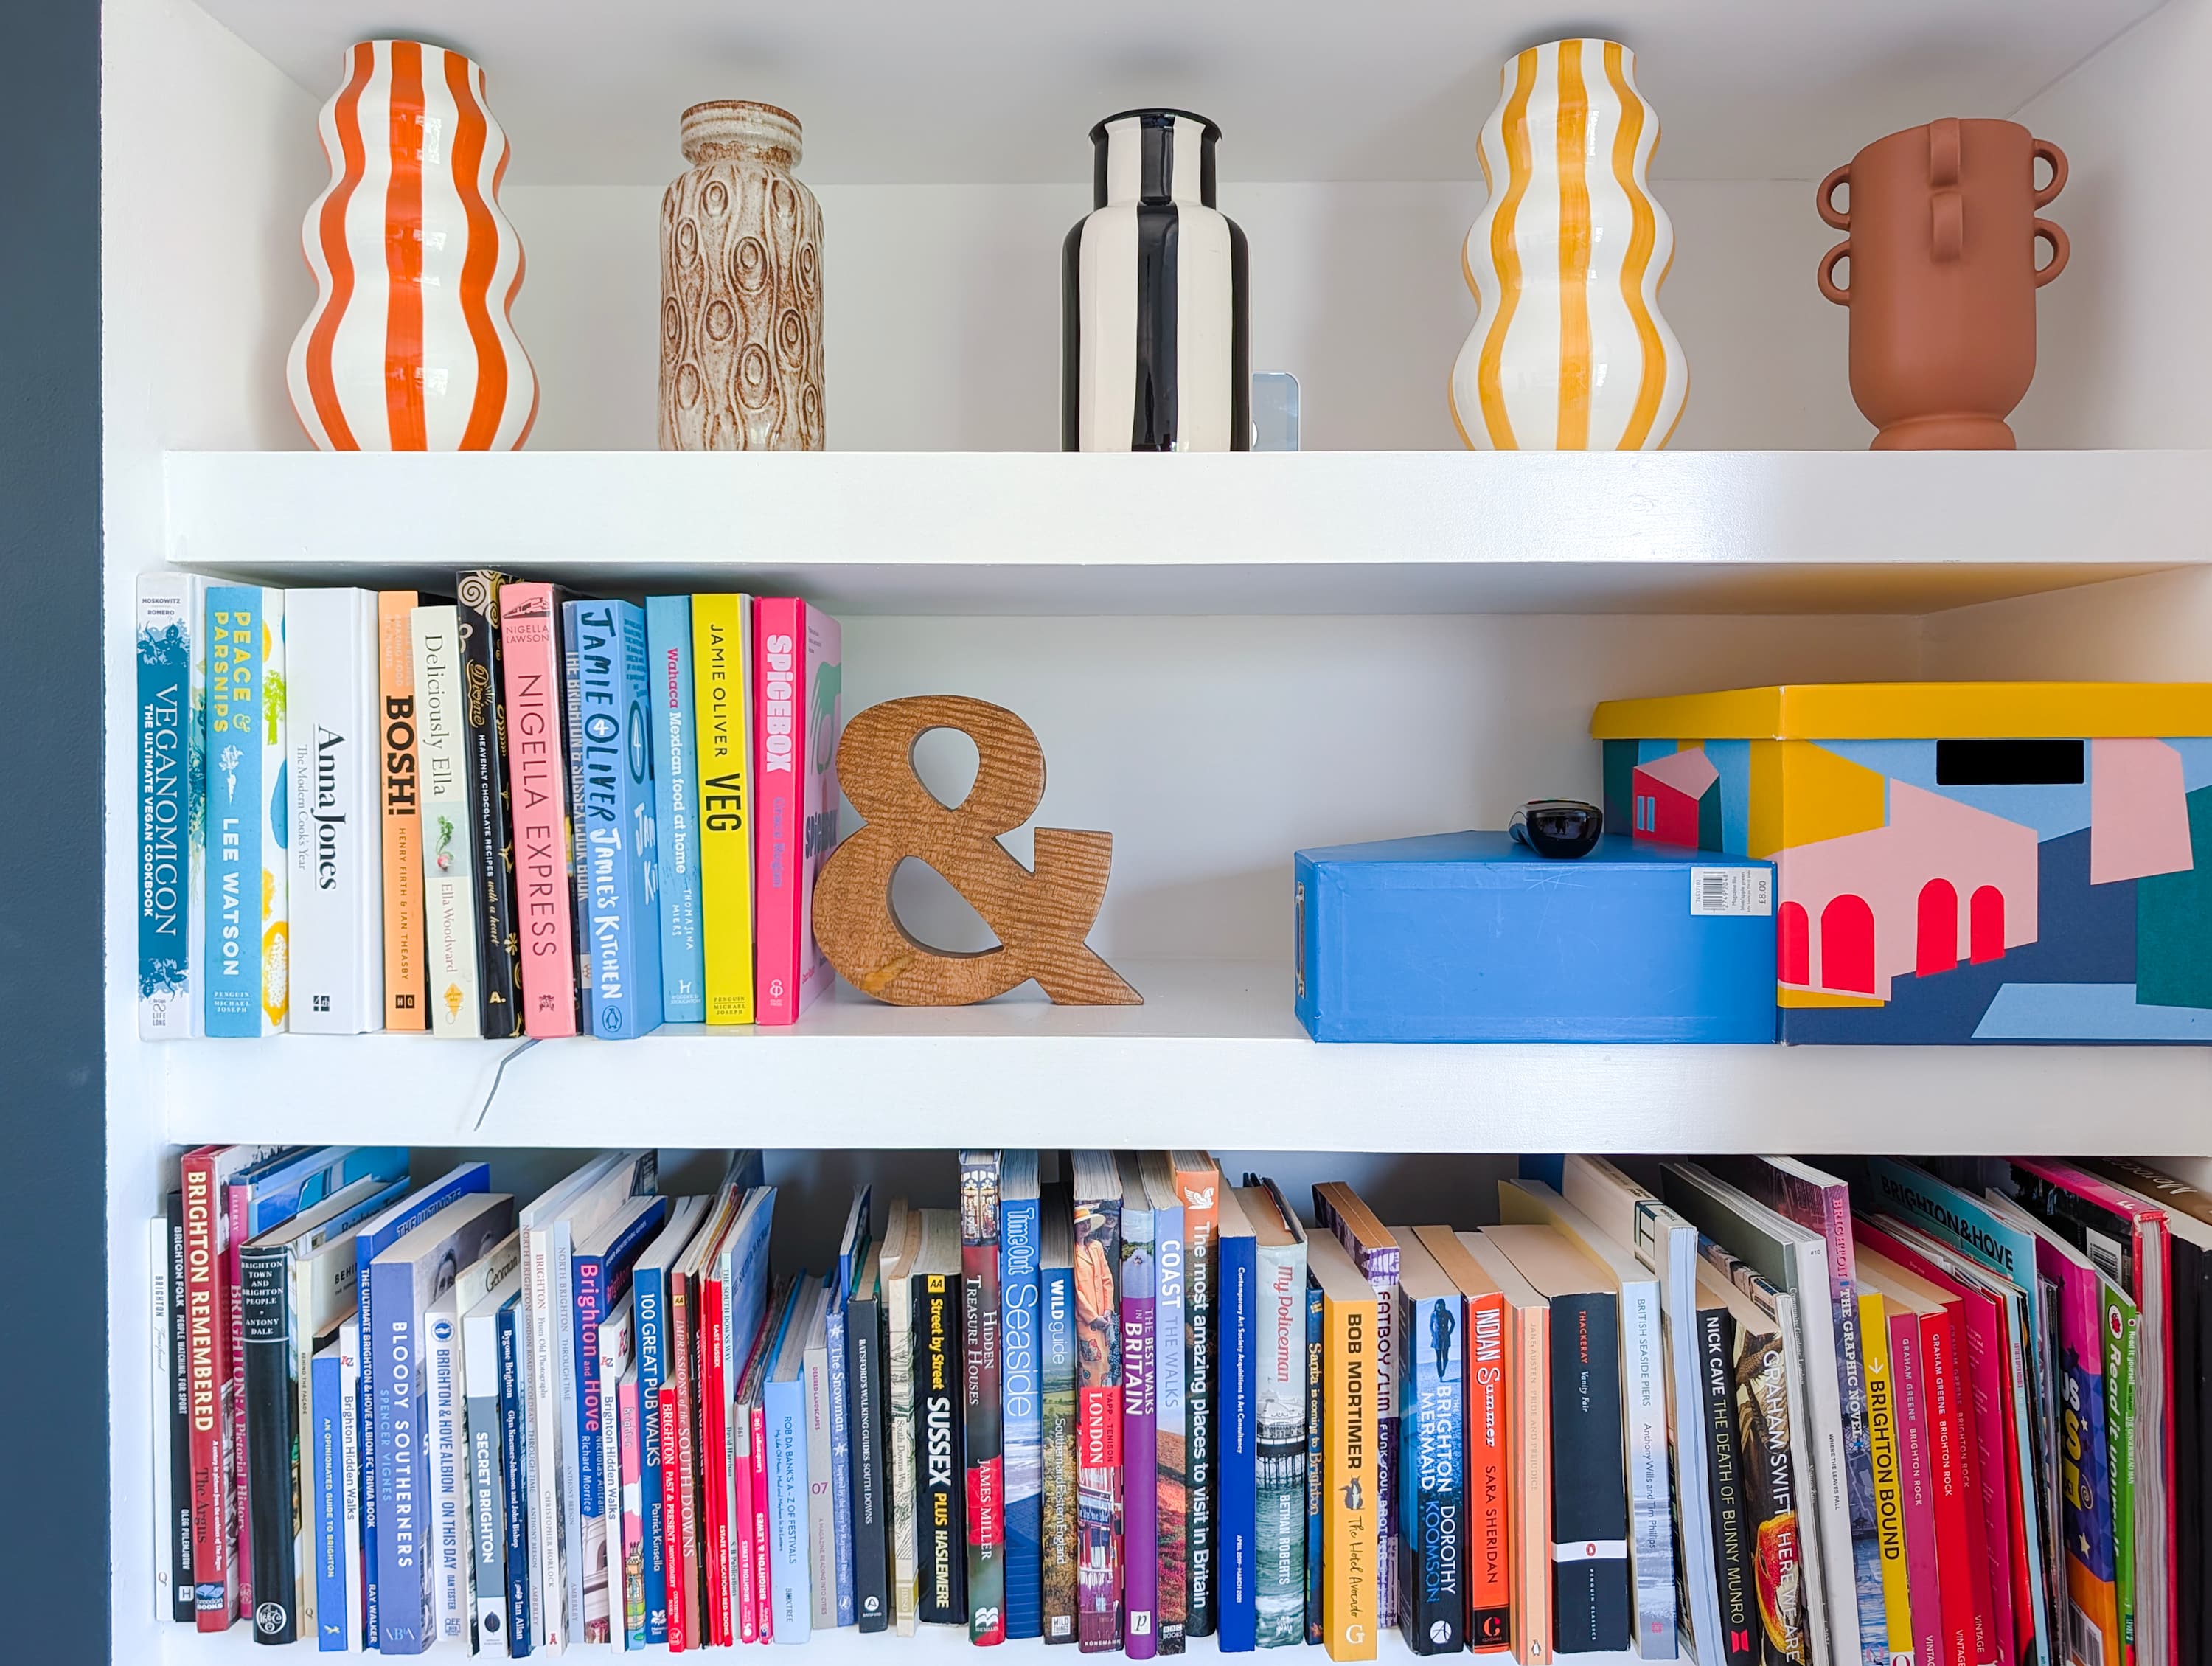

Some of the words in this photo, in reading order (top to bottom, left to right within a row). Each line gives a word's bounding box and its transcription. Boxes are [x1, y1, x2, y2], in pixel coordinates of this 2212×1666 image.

[214, 612, 228, 732] PARSNIPS
[234, 612, 250, 701] PEACE
[581, 608, 616, 704] JAMIE
[711, 624, 724, 680] JAMIE
[423, 634, 449, 749] Deliciously
[668, 648, 678, 708] Wahaca
[145, 704, 153, 729] THE
[234, 713, 250, 732] &
[518, 675, 549, 808] NIGELLA
[713, 687, 727, 757] OLIVER
[145, 732, 153, 794] ULTIMATE
[298, 745, 307, 764] The
[318, 724, 346, 808] Anna
[386, 695, 415, 815] BOSH!
[479, 735, 487, 780] HEAVENLY
[585, 714, 619, 821] OLIVER
[669, 712, 682, 775] Mexican
[298, 767, 308, 808] Modern
[431, 757, 451, 795] Ella
[673, 779, 684, 811] food
[706, 773, 742, 830] VEG
[145, 797, 153, 839] VEGAN
[156, 684, 177, 935] VEGANOMICON
[298, 811, 308, 845] Cook's
[482, 783, 492, 836] CHOCOLATE
[675, 815, 684, 830] at
[223, 819, 238, 861] LEE
[299, 848, 308, 870] Year
[311, 809, 347, 889] Jones
[675, 833, 686, 874] home
[145, 844, 153, 917] COOKBOOK
[526, 825, 557, 957] EXPRESS
[590, 827, 622, 908] JAMIE'S
[1758, 881, 1767, 904] £8.00
[442, 884, 452, 905] Ella
[684, 889, 693, 950] THOMASINA
[223, 872, 238, 975] WATSON
[442, 907, 456, 972] Woodward
[672, 905, 681, 936] MIERS
[400, 935, 408, 980] THEASBY
[594, 917, 622, 999] KITCHEN
[174, 1226, 184, 1279] BRIGHTON
[188, 1171, 209, 1283] BRIGHTON
[1194, 1221, 1210, 1257] The
[175, 1281, 184, 1306] FOLK
[1162, 1240, 1180, 1308] COAST
[1194, 1263, 1208, 1310] most
[1273, 1266, 1293, 1293] My
[578, 1264, 599, 1356] Brighton
[641, 1293, 655, 1319] 100
[931, 1298, 943, 1335] Street
[1135, 1309, 1142, 1319] IN
[1145, 1308, 1153, 1333] THE
[1840, 1289, 1852, 1319] THE
[503, 1330, 512, 1360] Bygone
[643, 1323, 658, 1374] GREAT
[832, 1345, 842, 1368] The
[931, 1337, 942, 1350] by
[1006, 1283, 1038, 1416] Seaside
[1165, 1316, 1178, 1347] THE
[1189, 1315, 1209, 1394] amazing
[1277, 1296, 1293, 1381] Policeman
[1348, 1313, 1362, 1353] BOB
[1476, 1308, 1500, 1362] INDIAN
[1579, 1310, 1587, 1363] THACKERAY
[1707, 1317, 1722, 1353] NICK
[1843, 1321, 1857, 1386] GRAPHIC
[1933, 1333, 1943, 1375] GRAHAM
[192, 1291, 212, 1431] REMEMBERED
[392, 1322, 408, 1408] BLOODY
[504, 1361, 513, 1398] Brighton
[933, 1353, 944, 1389] Street
[1125, 1322, 1143, 1415] BRITAIN
[1165, 1352, 1178, 1407] WALKS
[1579, 1371, 1589, 1394] Vanity
[1710, 1358, 1725, 1395] CAVE
[380, 1389, 391, 1445] SPENCER
[584, 1381, 601, 1431] Hove
[644, 1378, 659, 1408] PUB
[833, 1372, 844, 1431] Snowman
[1348, 1361, 1362, 1468] MORTIMER
[1477, 1367, 1500, 1447] Summer
[1581, 1397, 1590, 1412] Fair
[1713, 1399, 1728, 1429] THE
[1763, 1350, 1784, 1450] GRAHAM
[1848, 1389, 1862, 1438] NOVEL
[1935, 1378, 1946, 1414] GREENE
[324, 1418, 330, 1430] AN
[646, 1412, 660, 1467] WALKS
[927, 1396, 951, 1487] SUSSEX
[1089, 1392, 1103, 1463] LONDON
[1191, 1400, 1208, 1460] places
[1420, 1392, 1435, 1490] MERMAID
[1436, 1386, 1452, 1493] BRIGHTON
[1870, 1381, 1892, 1482] BRIGHTON
[1939, 1421, 1950, 1468] BRIGHTON
[324, 1433, 333, 1490] OPINIONATED
[381, 1452, 392, 1501] VIGNES
[476, 1432, 490, 1485] SECRET
[978, 1459, 991, 1502] JAMES
[1193, 1463, 1208, 1482] to
[1716, 1434, 1732, 1482] DEATH
[1944, 1471, 1952, 1496] ROCK
[394, 1420, 413, 1567] SOUTHERNERS
[934, 1493, 947, 1525] PLUS
[1193, 1487, 1209, 1524] visit
[1486, 1465, 1496, 1504] SARA
[1720, 1487, 1734, 1504] OF
[1770, 1454, 1790, 1516] SWIFT
[327, 1521, 333, 1531] TO
[479, 1489, 493, 1563] BRIGHTON
[980, 1507, 992, 1560] MILLER
[1193, 1528, 1208, 1544] in
[1348, 1516, 1363, 1538] The
[1441, 1506, 1455, 1594] DOROTHY
[1486, 1510, 1498, 1583] SHERIDAN
[1722, 1510, 1739, 1561] BUNNY
[1879, 1489, 1899, 1561] BOUND
[935, 1530, 949, 1608] HASLEMERE
[1349, 1542, 1363, 1572] Hotel
[1425, 1501, 1439, 1603] KOOMSON
[1777, 1533, 1794, 1583] HERE
[1193, 1549, 1209, 1608] Britain
[1349, 1576, 1363, 1617] Avocado
[1728, 1567, 1744, 1623] MUNRO
[1781, 1586, 1798, 1617] WE
[1784, 1625, 1801, 1662] ARE
